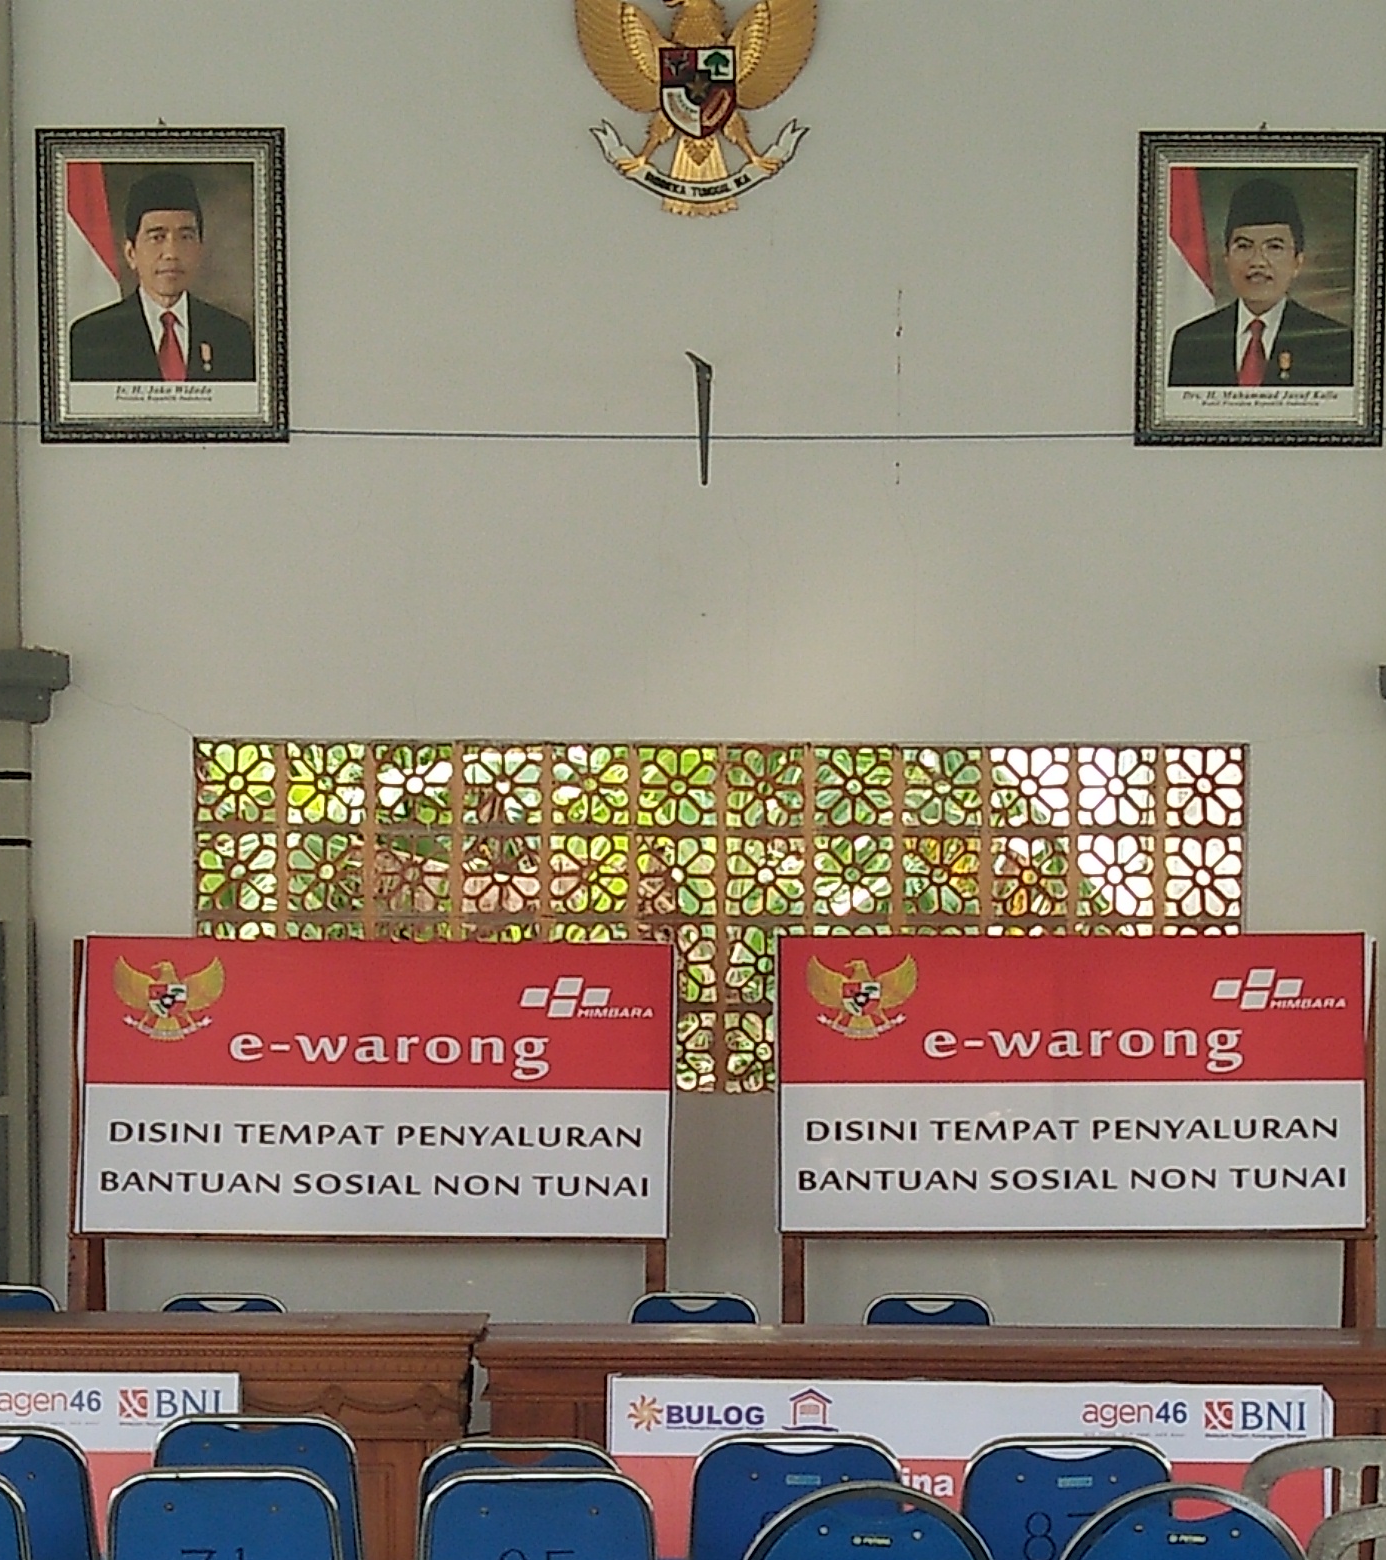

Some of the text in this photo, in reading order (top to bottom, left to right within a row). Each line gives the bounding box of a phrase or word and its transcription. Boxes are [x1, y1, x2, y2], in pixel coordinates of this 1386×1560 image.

[228, 1031, 551, 1081] e-warong
[922, 1024, 1245, 1073] e-warong
[109, 1120, 643, 1149] DISINI TEMPAT PENYALURAN
[805, 1117, 1339, 1142] DISINI TEMPAT PENYALURAN
[99, 1170, 650, 1198] BANTUAN SOSIAL NON TUNAI
[797, 1167, 1347, 1192] BANTUAN SOSIAL NON TUNAI
[155, 1389, 222, 1416] BNI
[665, 1405, 765, 1426] BULOG
[1082, 1401, 1188, 1428] agen46
[1241, 1401, 1307, 1431] BNI
